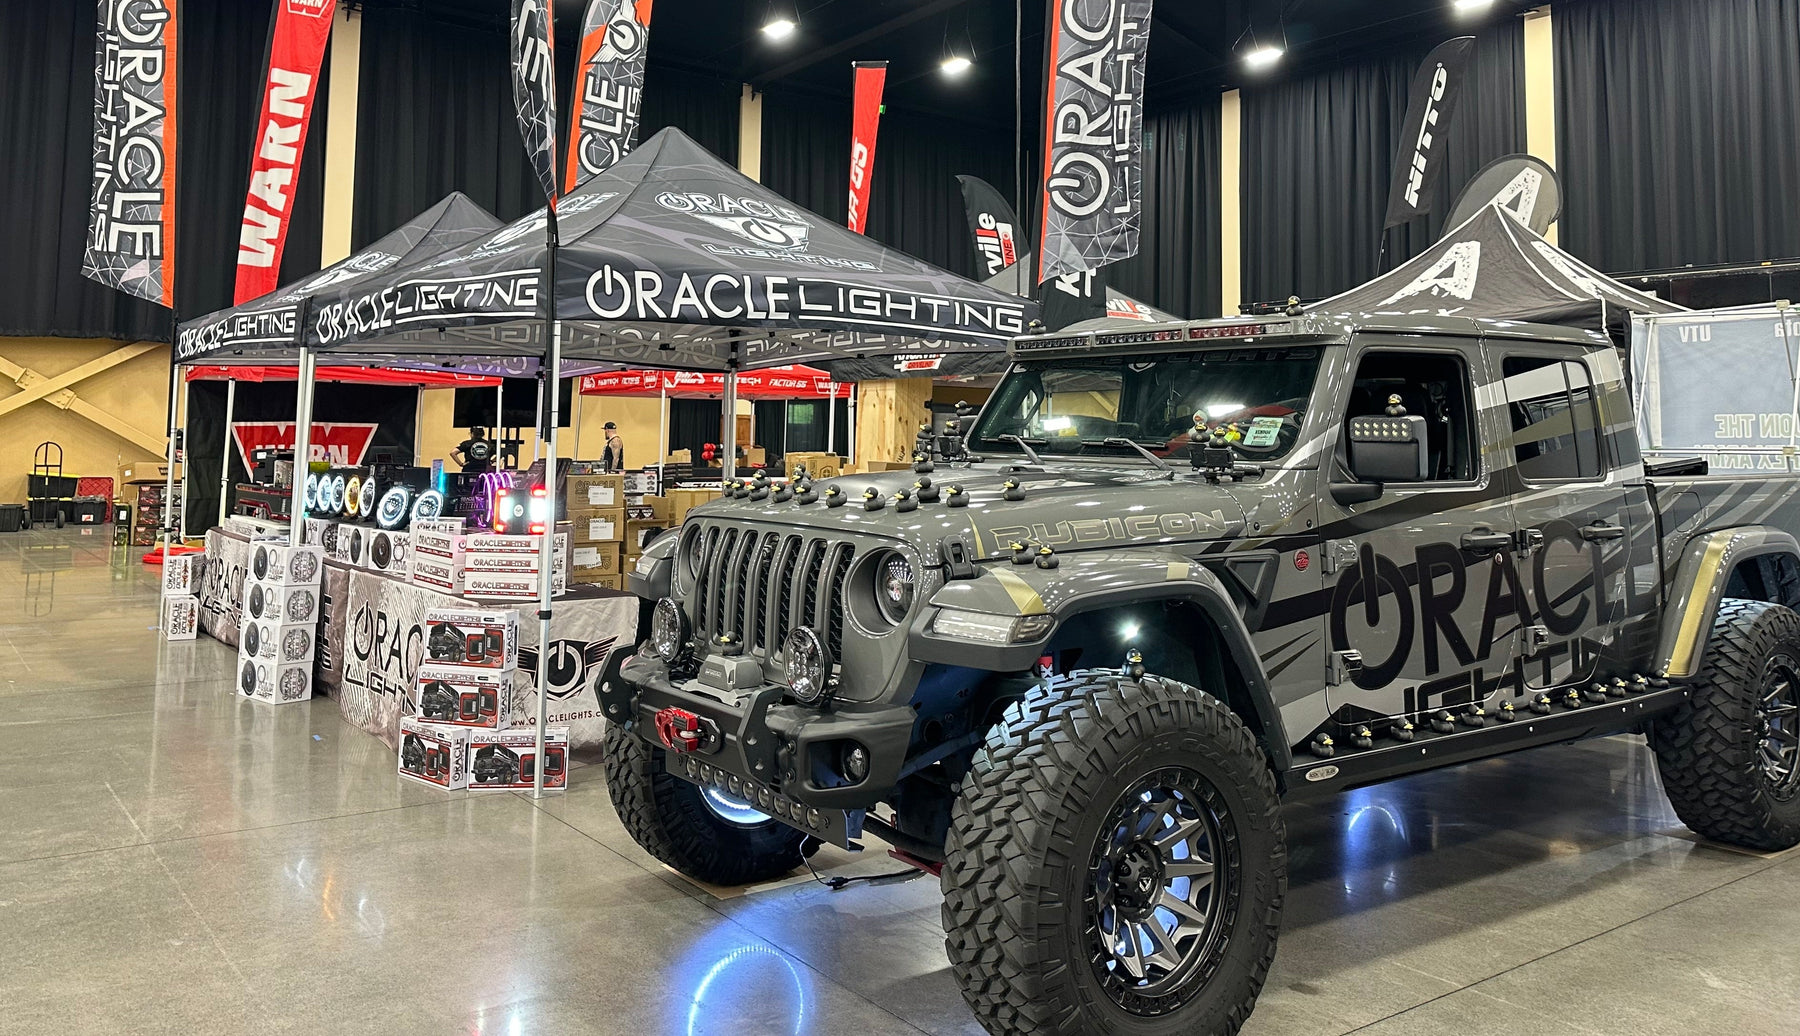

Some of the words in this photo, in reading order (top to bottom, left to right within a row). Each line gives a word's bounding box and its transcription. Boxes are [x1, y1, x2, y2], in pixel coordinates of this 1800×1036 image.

[109, 0, 170, 257] ORACLE
[238, 67, 312, 268] WARN
[315, 286, 397, 343] ORACLE
[395, 277, 539, 314] LIGHTING
[585, 264, 790, 320] ORACLE
[798, 284, 1025, 334] LIGHTING
[178, 319, 227, 358] ORACLE
[223, 312, 296, 339] LIGHTING
[713, 377, 761, 386] FATECH
[989, 509, 1228, 550] RUBICON
[1330, 502, 1660, 690] ORACLE
